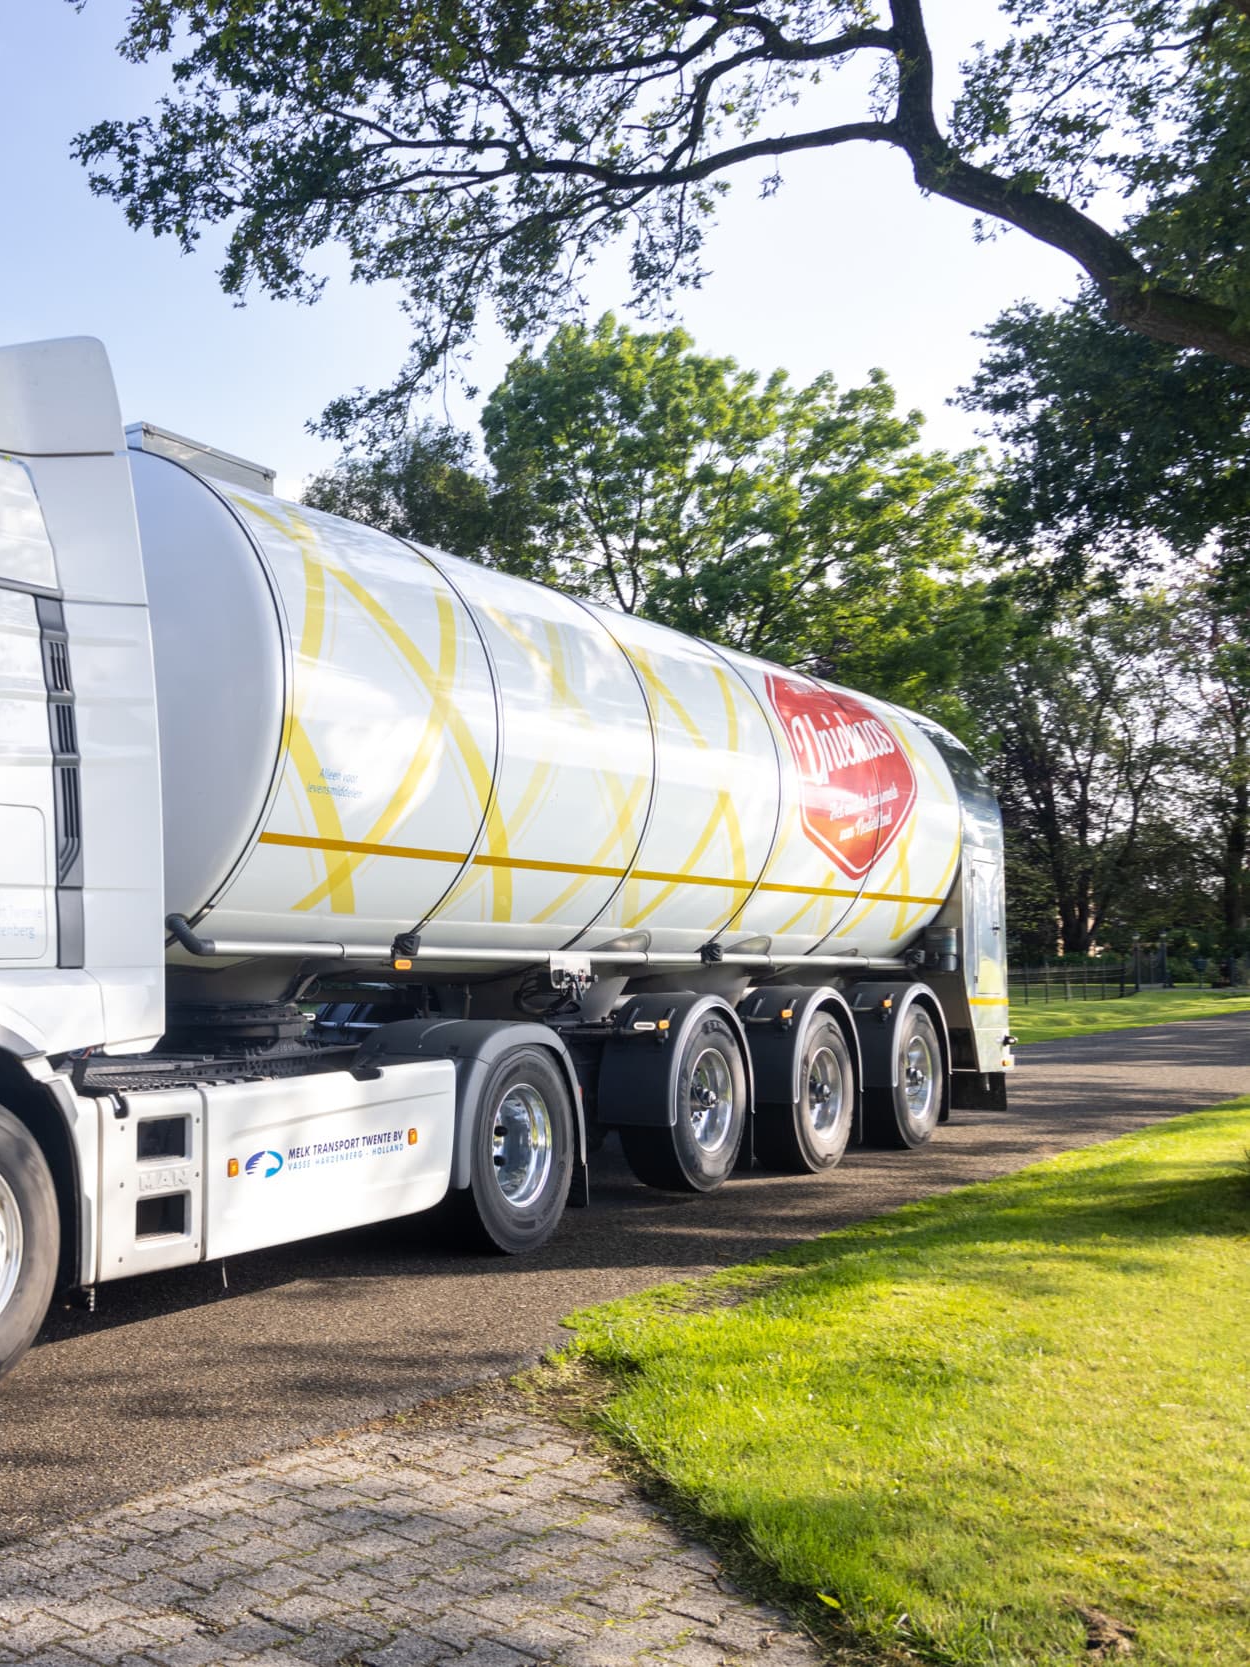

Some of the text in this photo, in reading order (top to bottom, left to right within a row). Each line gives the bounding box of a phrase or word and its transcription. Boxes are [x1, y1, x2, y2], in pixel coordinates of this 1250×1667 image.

[288, 1130, 404, 1160] MELK TRANSPORT TWENTE BV
[372, 1143, 404, 1156] HOLLAND
